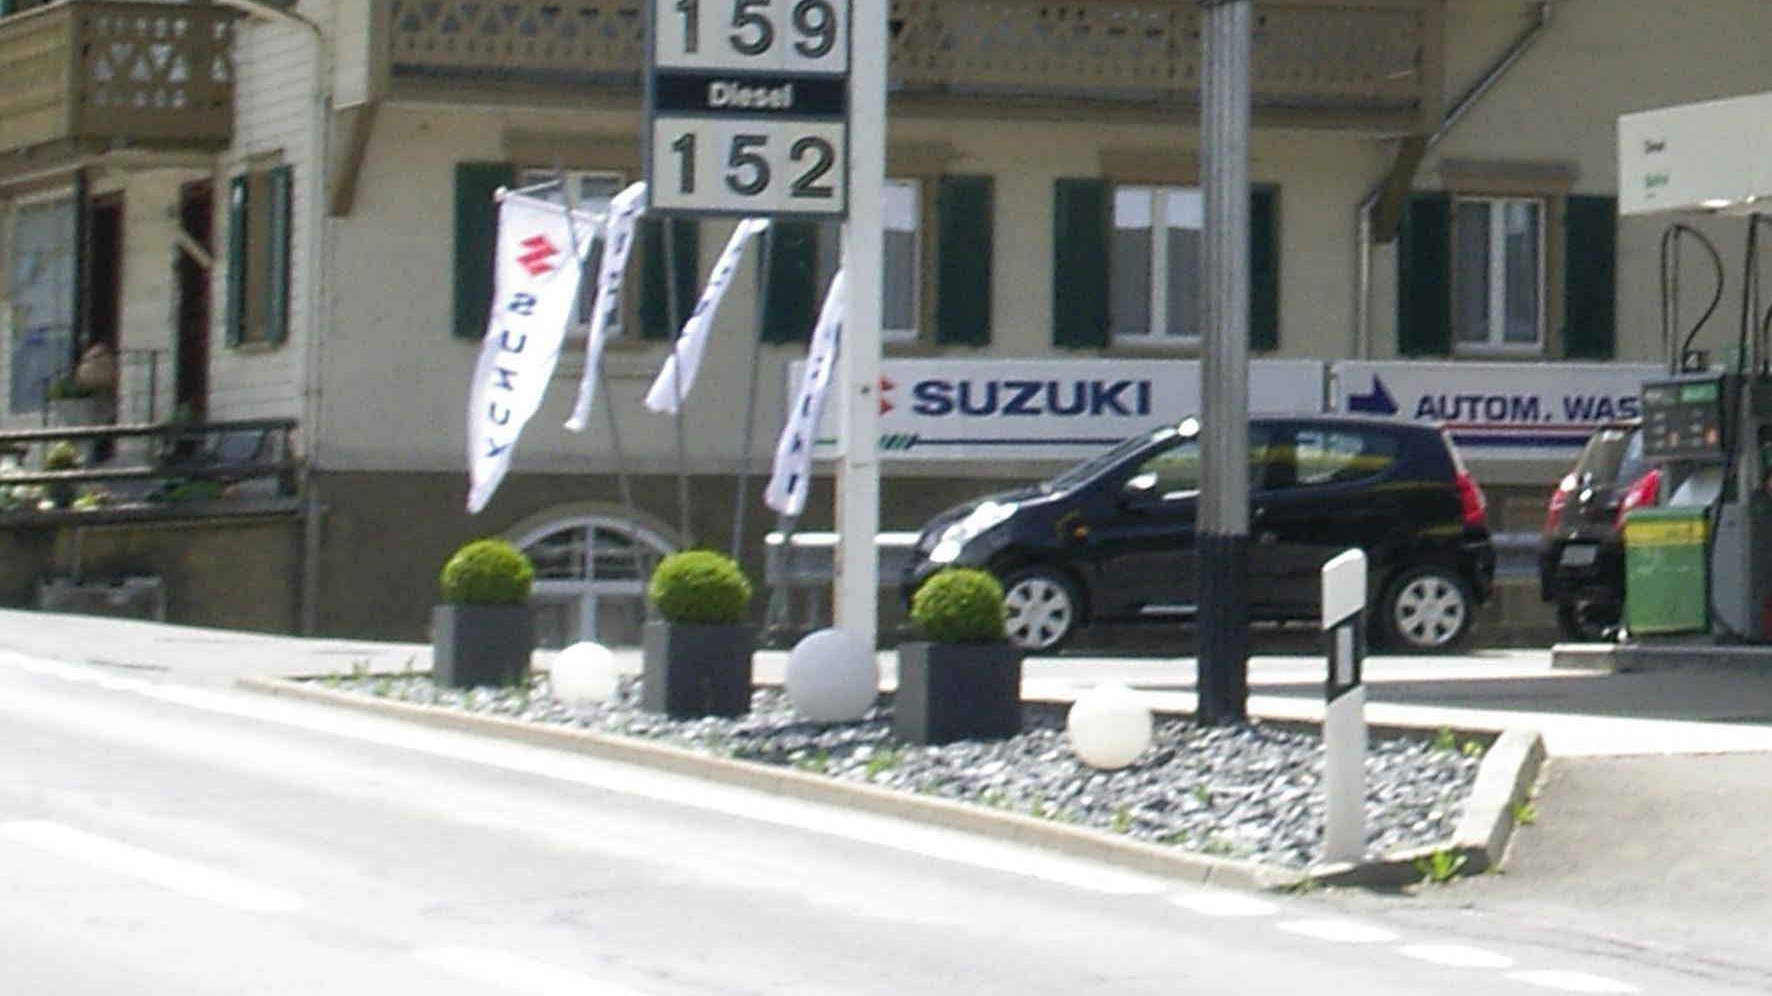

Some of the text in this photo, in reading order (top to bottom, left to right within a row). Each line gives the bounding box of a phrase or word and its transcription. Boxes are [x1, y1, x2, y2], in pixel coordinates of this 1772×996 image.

[708, 81, 793, 108] Diesel
[672, 132, 835, 199] 152
[913, 379, 1152, 417] SUZUKI
[1415, 394, 1553, 422] AUTOM.
